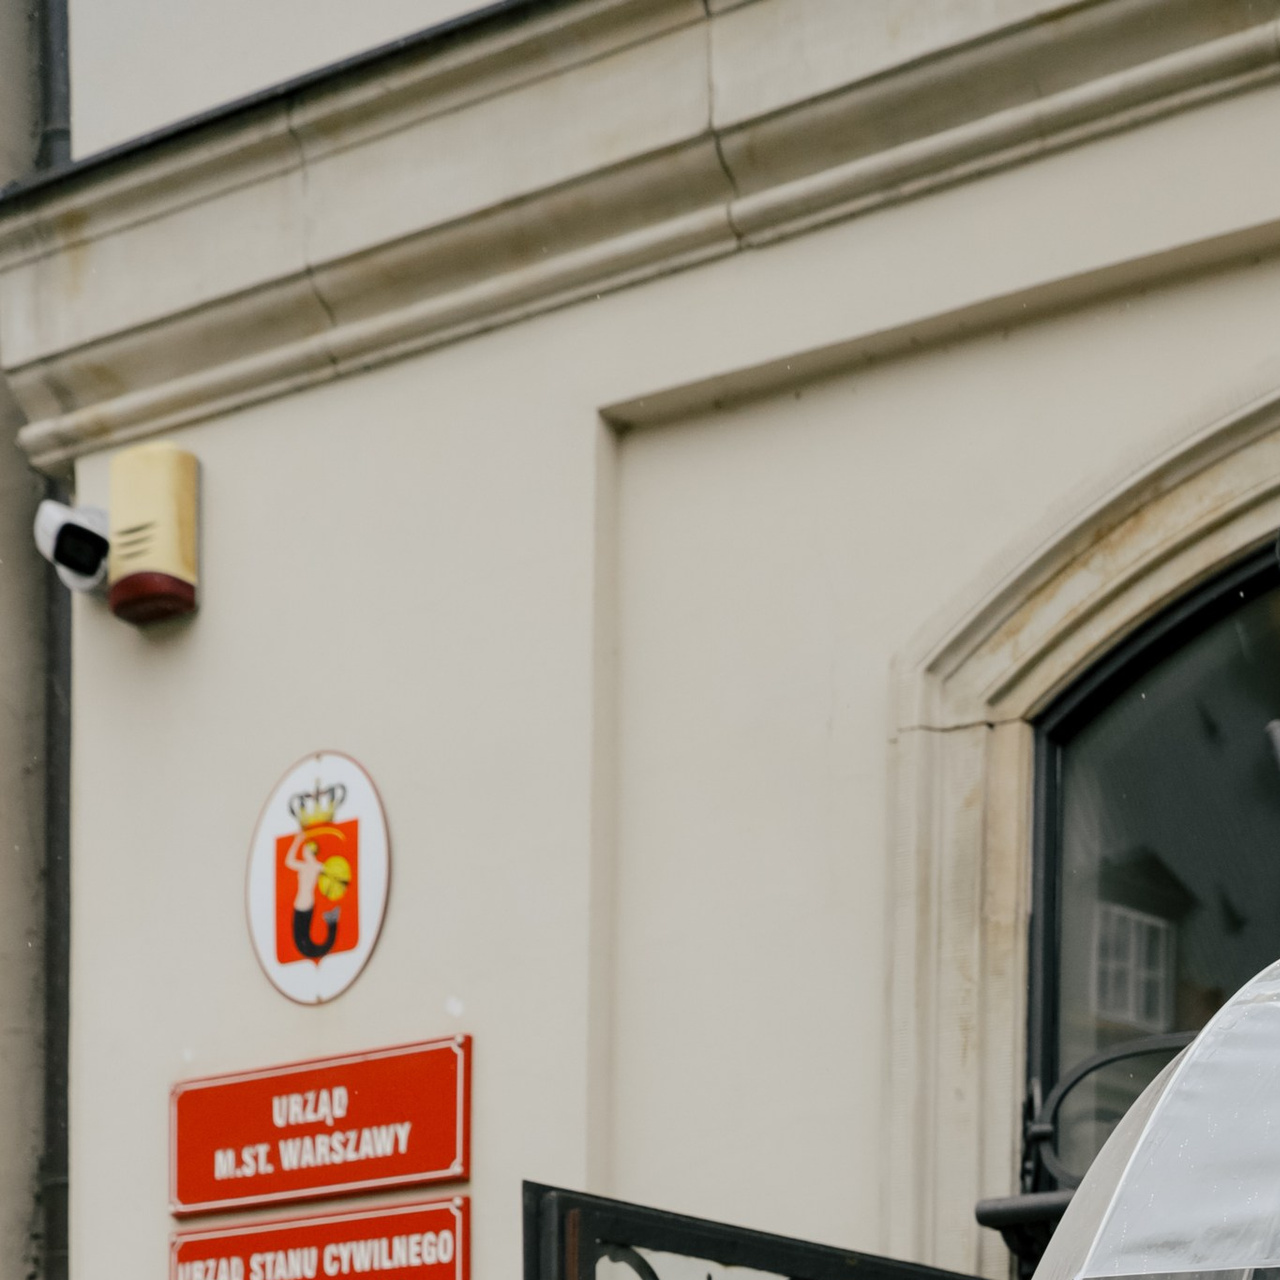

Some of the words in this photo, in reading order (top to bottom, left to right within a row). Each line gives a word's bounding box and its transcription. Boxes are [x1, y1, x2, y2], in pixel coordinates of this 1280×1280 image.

[271, 1086, 348, 1127] URZĄD
[213, 1143, 275, 1180] M.ST.
[278, 1121, 412, 1171] WARSZAWY
[323, 1229, 454, 1277] CYWILNEGO
